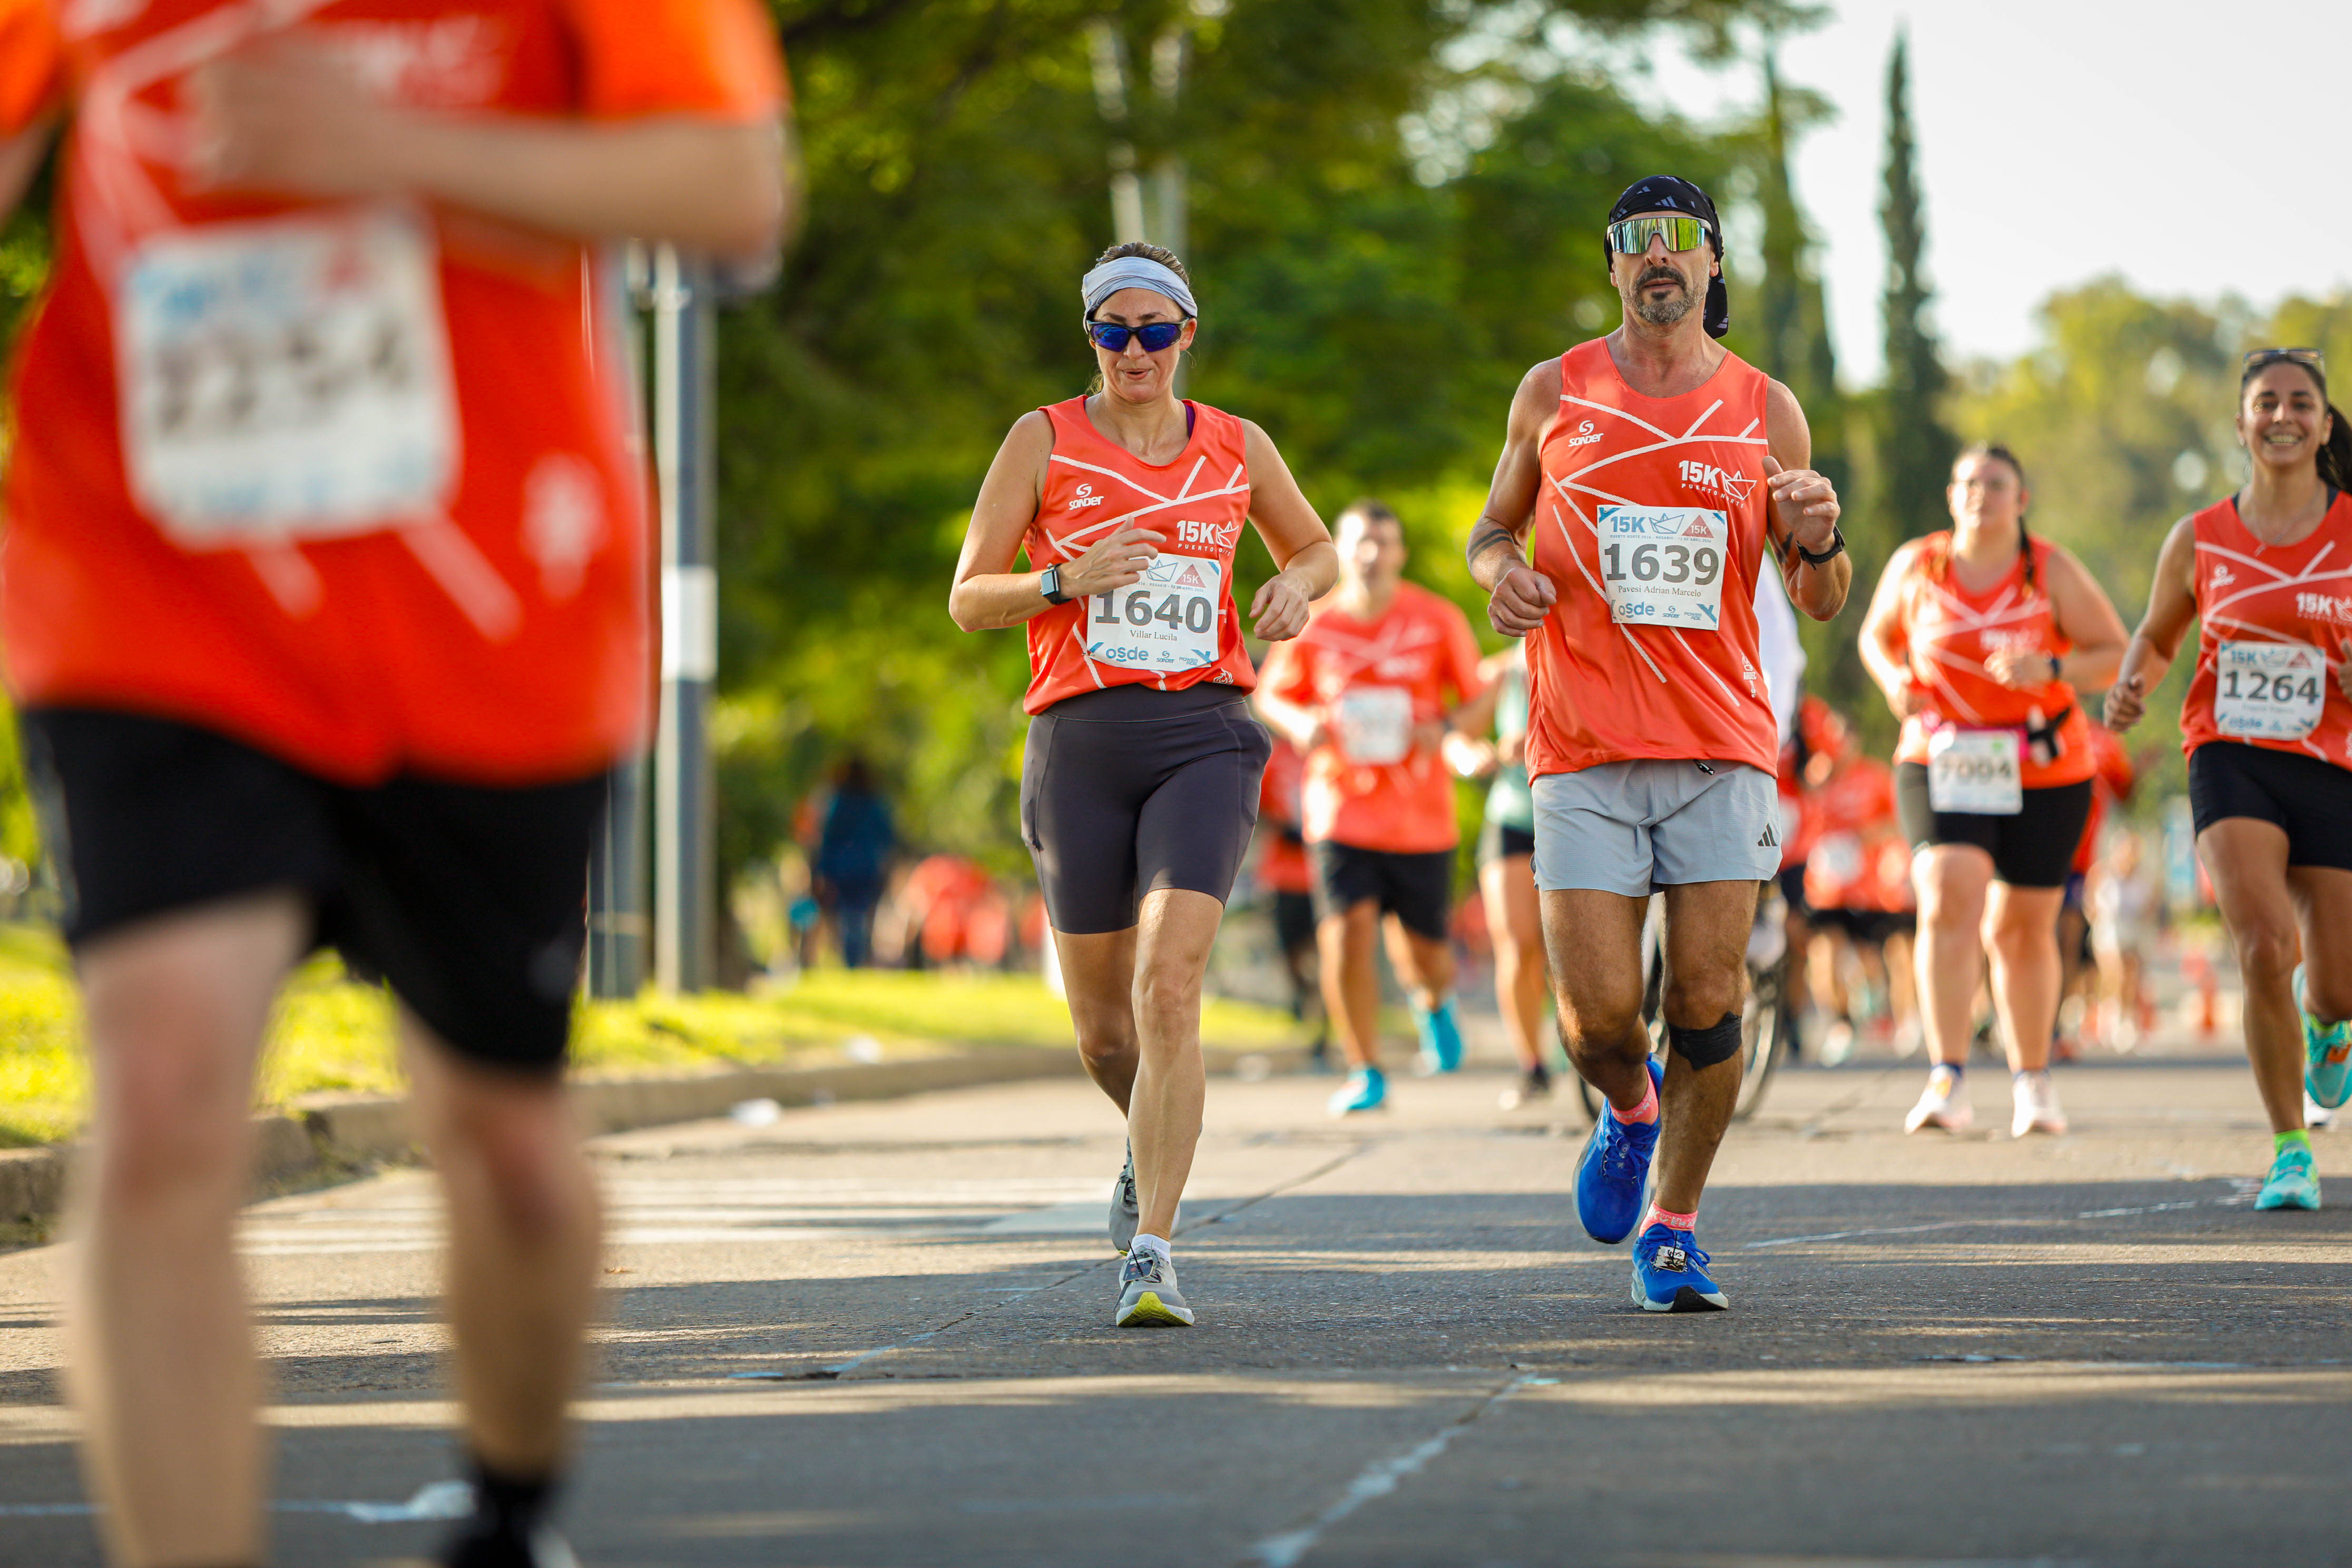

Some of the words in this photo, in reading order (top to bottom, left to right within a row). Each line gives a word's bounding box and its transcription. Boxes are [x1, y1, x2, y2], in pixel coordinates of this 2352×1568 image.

[1679, 460, 1722, 488] 15K
[1681, 483, 1718, 495] PUERTO
[1720, 493, 1745, 508] NORTE
[1177, 520, 1216, 544] 15K
[1610, 516, 1645, 533] 15K
[1690, 525, 1708, 535] 15K
[1178, 543, 1214, 552] PUERTO
[1604, 544, 1719, 585] 1639
[1182, 574, 1199, 584] 15K
[1643, 586, 1670, 594] Adrian
[1672, 587, 1701, 597] Marcelo
[1095, 590, 1212, 634] 1640
[1619, 601, 1655, 617] osde
[2295, 592, 2333, 616] 15K
[1130, 630, 1152, 639] Villar
[1154, 632, 1178, 641] Lucila
[1105, 646, 1149, 661] osde
[2231, 650, 2258, 665] 15K
[2223, 670, 2320, 705] 1264
